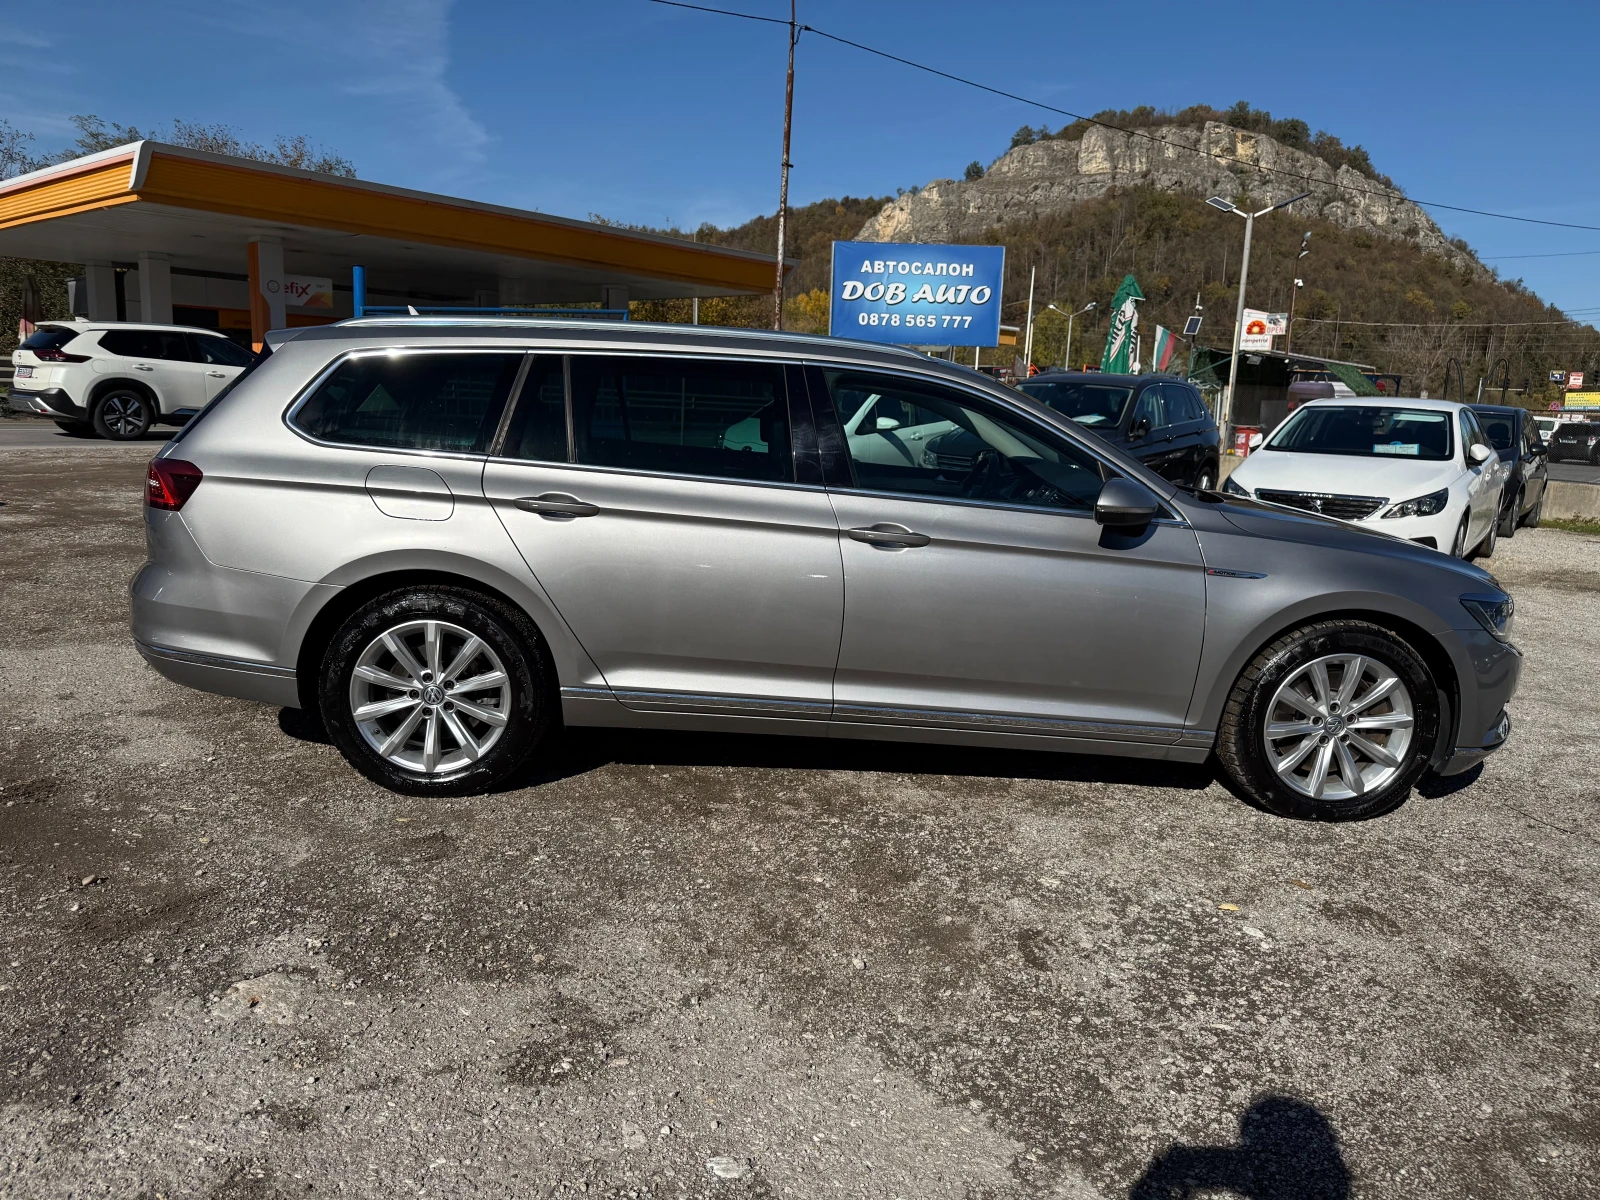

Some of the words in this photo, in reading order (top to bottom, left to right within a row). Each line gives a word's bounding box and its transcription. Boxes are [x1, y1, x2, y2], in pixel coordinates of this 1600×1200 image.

[860, 260, 974, 277] АВТОСАЛОН
[841, 280, 907, 305] DOB
[911, 283, 991, 305] AUTO
[858, 312, 901, 327] 0878
[905, 314, 937, 328] 565
[941, 315, 973, 329] 777
[1266, 326, 1284, 334] OPEN
